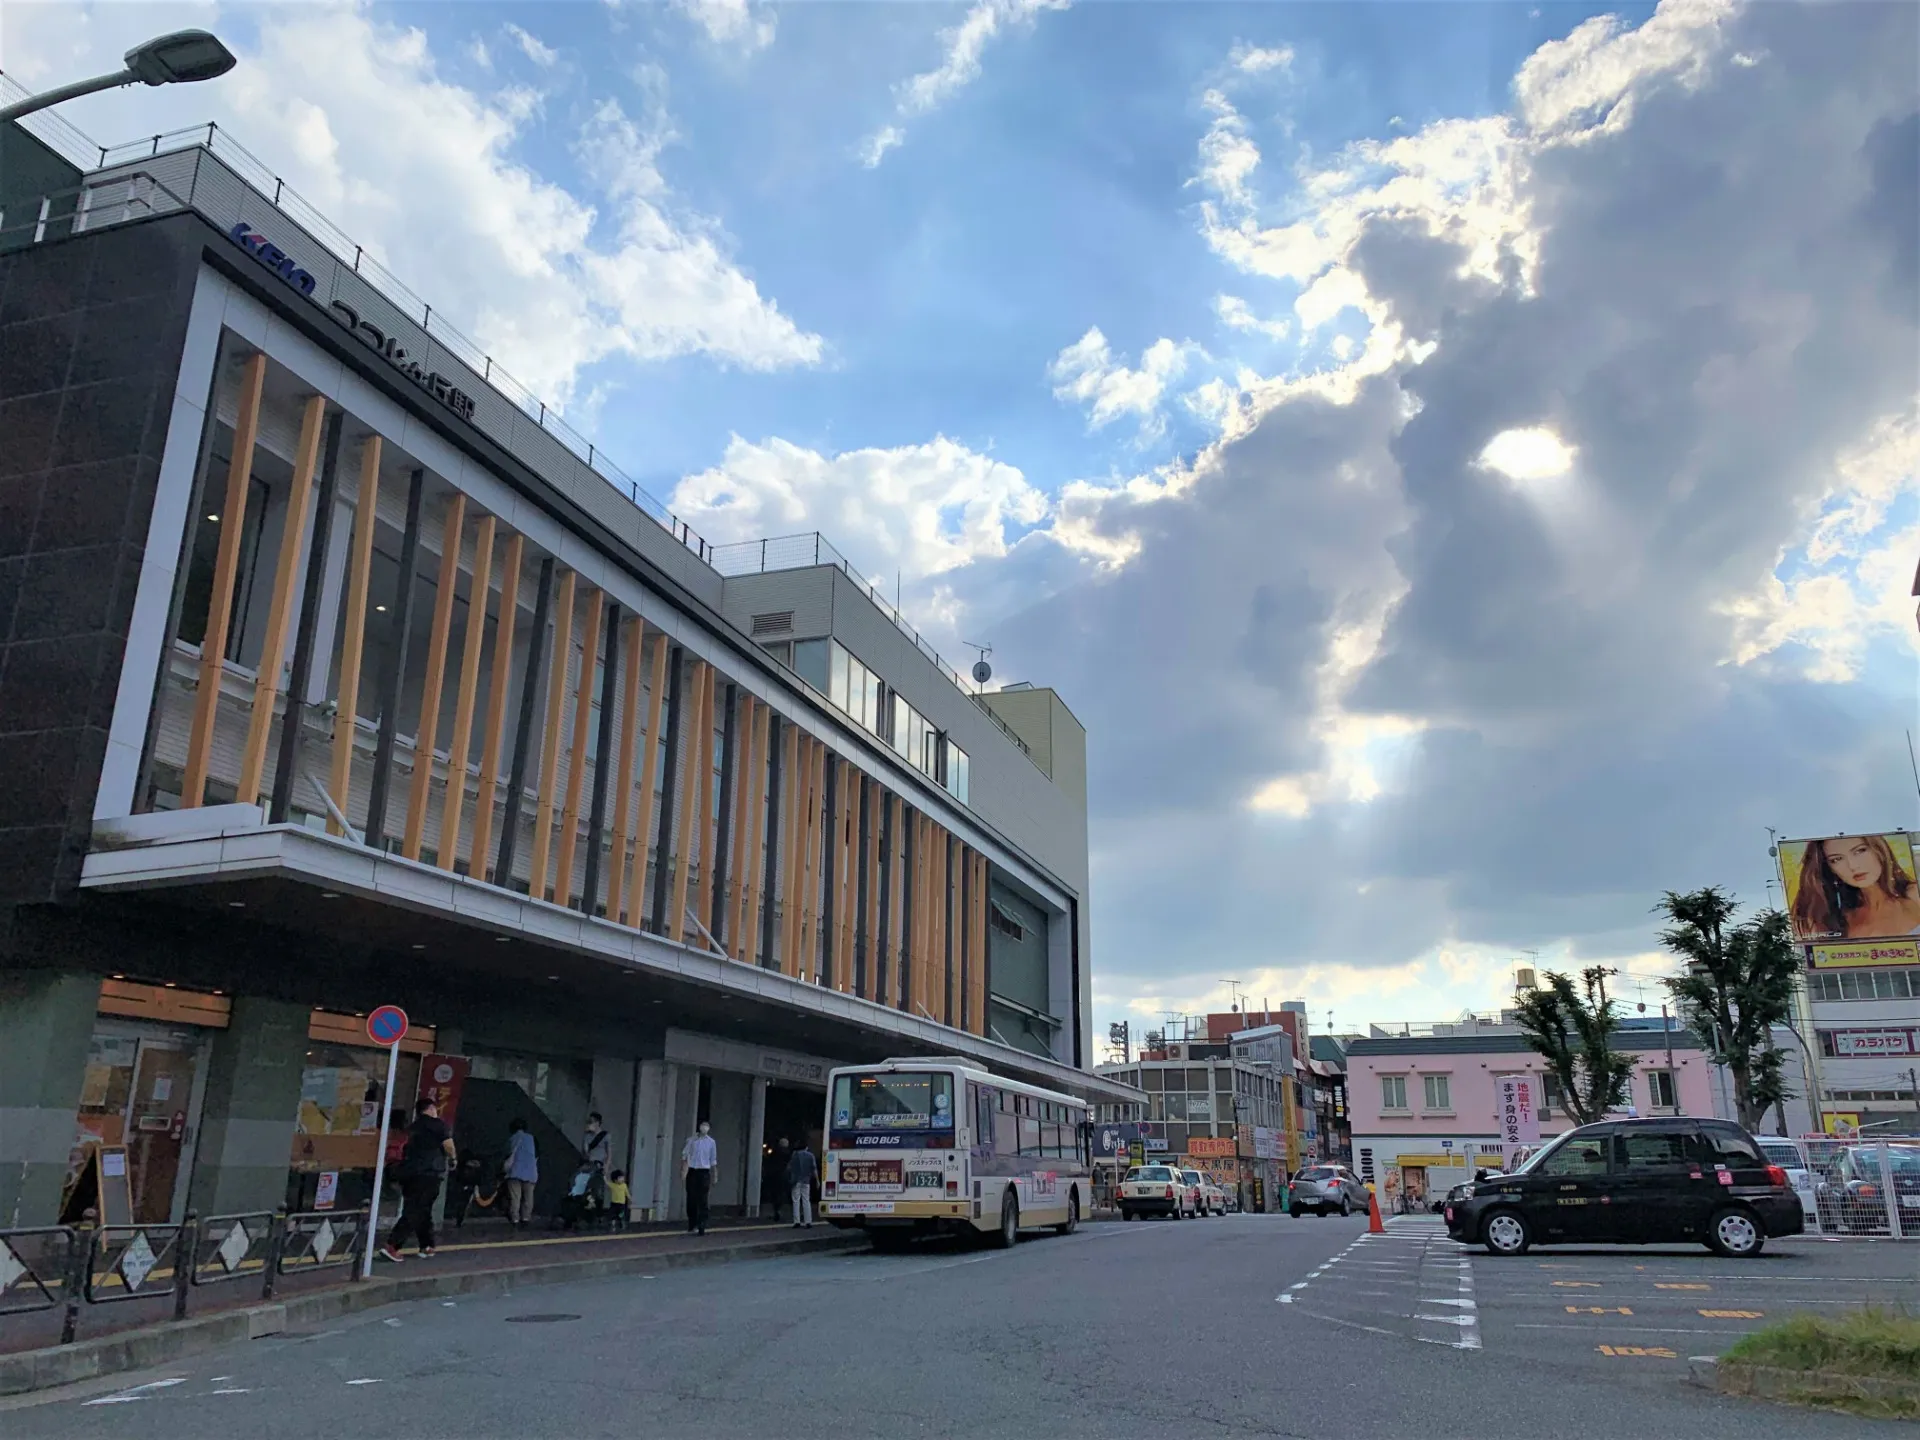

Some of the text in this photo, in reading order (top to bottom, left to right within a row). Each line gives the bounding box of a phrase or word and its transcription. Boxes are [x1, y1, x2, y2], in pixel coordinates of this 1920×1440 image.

[1855, 1037, 1903, 1048] カラオケ
[1504, 1083, 1519, 1143] まず身の安全
[856, 1136, 901, 1145] KEIO BUS
[1190, 1140, 1235, 1154] 買取専門店
[1198, 1159, 1234, 1171] 大黒屋
